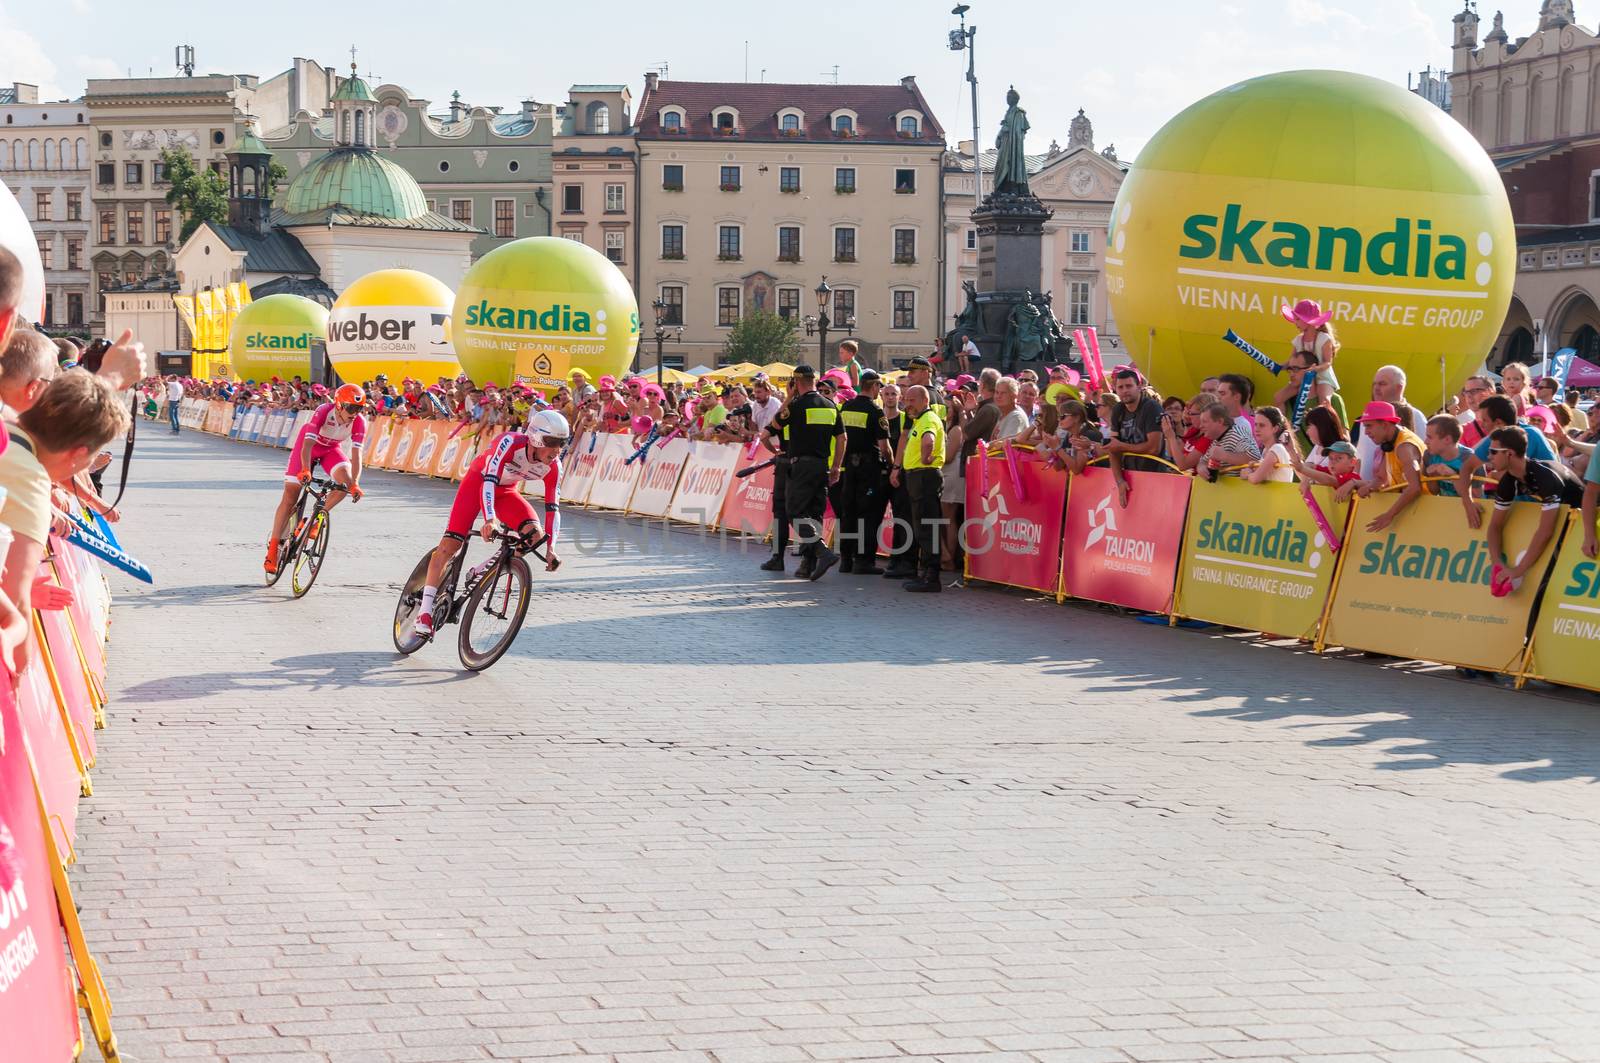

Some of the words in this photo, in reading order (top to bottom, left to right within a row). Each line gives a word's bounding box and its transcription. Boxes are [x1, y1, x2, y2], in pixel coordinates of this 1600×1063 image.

[1179, 203, 1467, 281] skandia
[464, 299, 592, 333] skandia
[1176, 284, 1264, 314] VIENNA
[1271, 295, 1419, 327] INURANCE
[1423, 307, 1485, 329] GROUP
[245, 331, 318, 350] skandi
[328, 313, 416, 343] weber
[355, 343, 416, 352] SAINT-GOBAIN
[464, 336, 498, 350] VIENNA
[570, 344, 606, 355] GROUP
[1233, 335, 1276, 373] FESTINA
[649, 461, 680, 491] LOTOS
[694, 466, 728, 496] LOTOS
[1000, 519, 1042, 544] TAURON
[1196, 510, 1308, 564] skandia
[1105, 535, 1155, 563] TAURON
[1191, 565, 1223, 584] VIENNA
[1223, 570, 1278, 594] INSURANCE
[1279, 581, 1314, 600] GROUP
[1552, 616, 1600, 640] VIENNA
